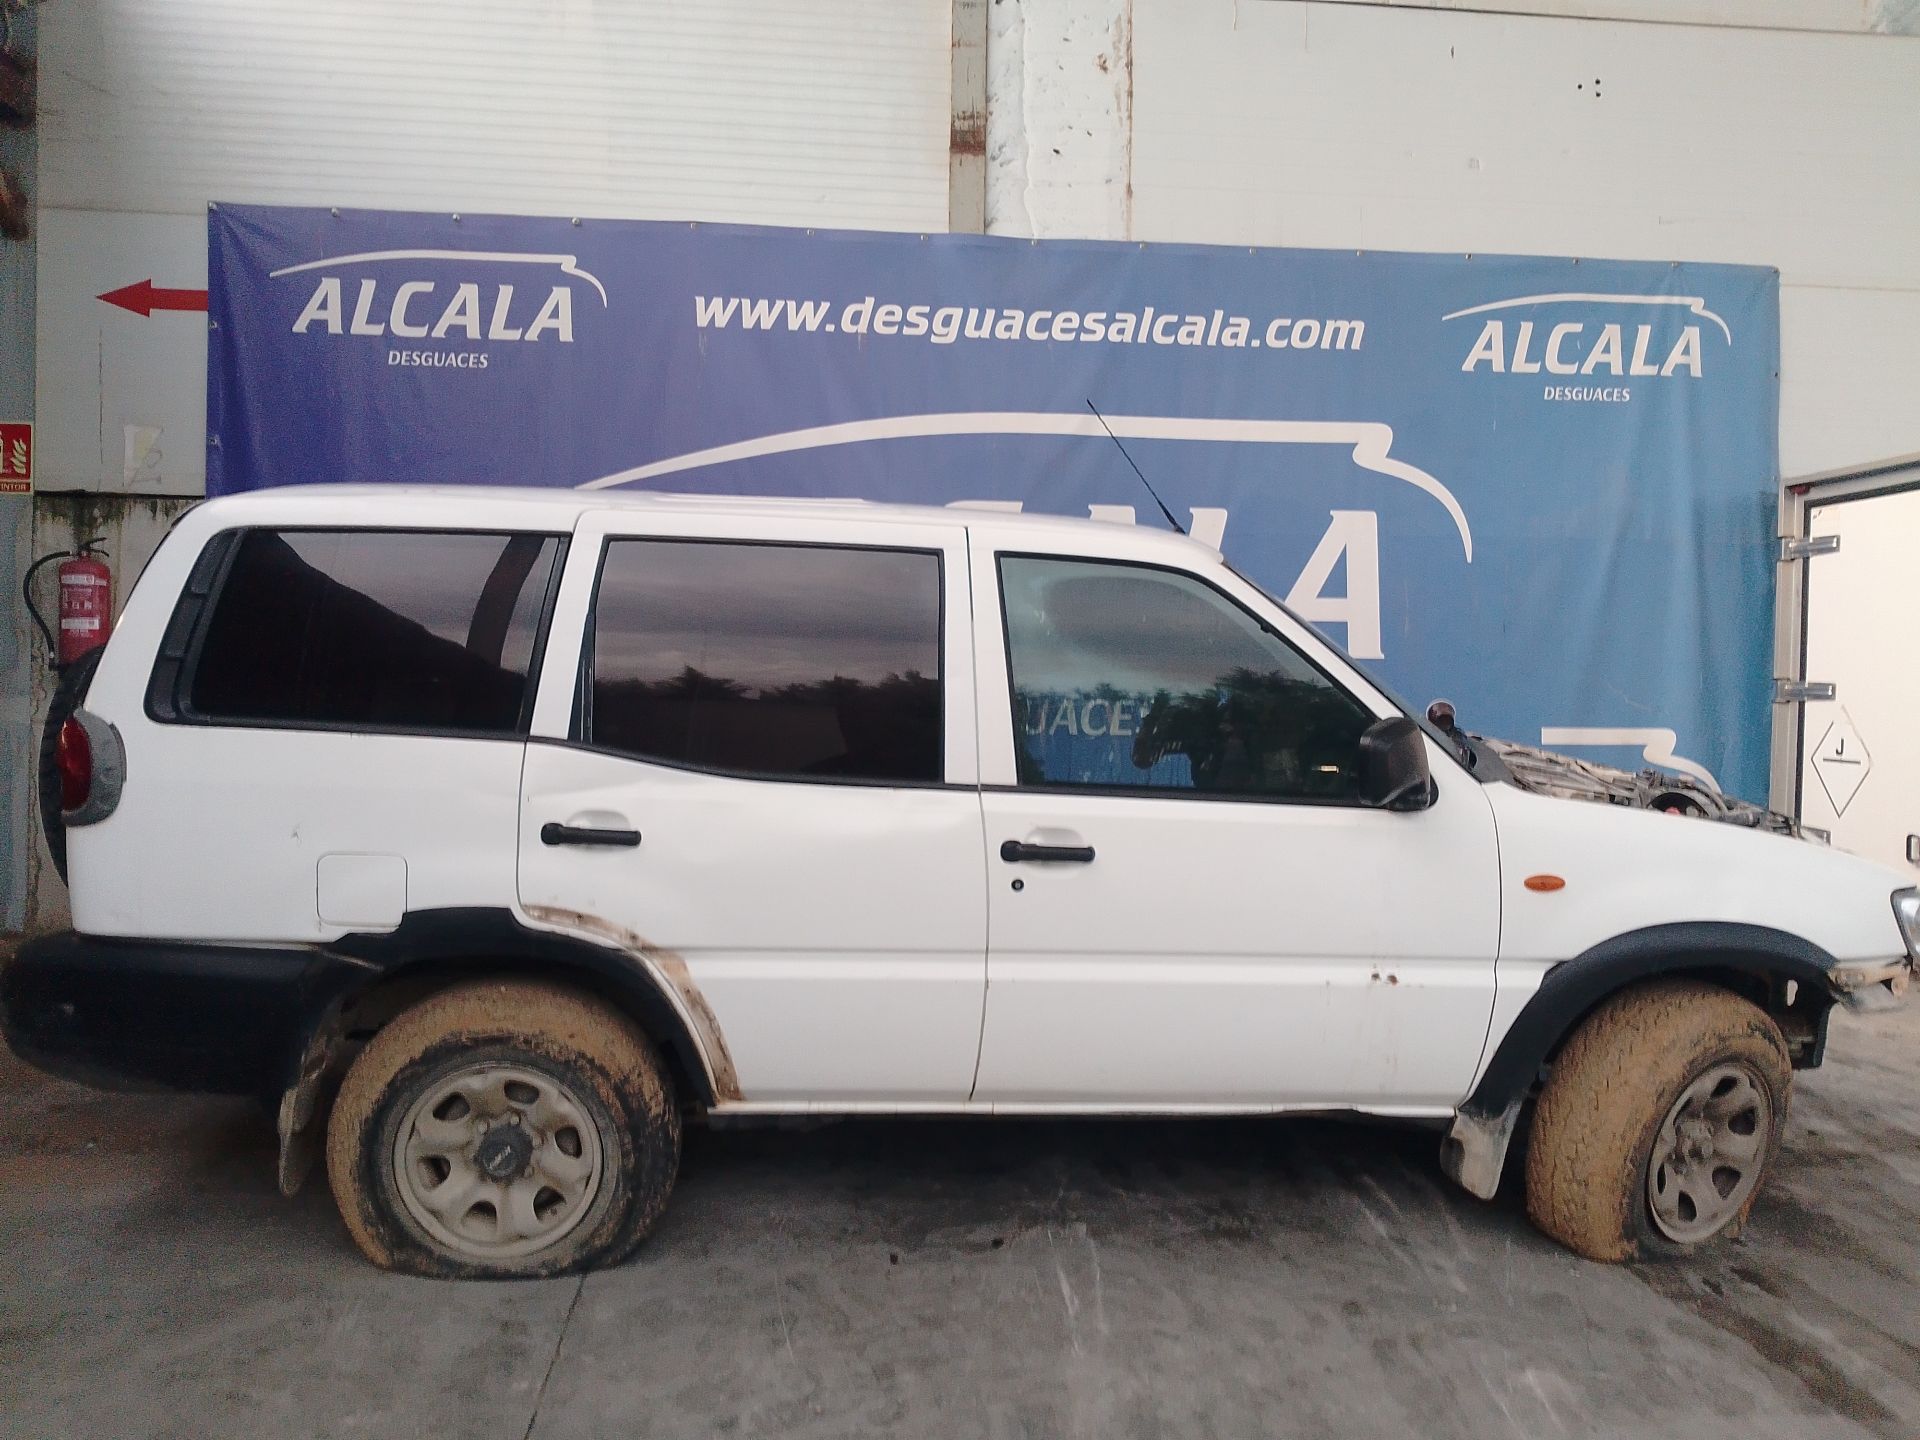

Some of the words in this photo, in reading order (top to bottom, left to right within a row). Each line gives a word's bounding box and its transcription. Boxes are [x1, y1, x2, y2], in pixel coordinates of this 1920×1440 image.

[291, 277, 574, 342] ALCALA
[695, 296, 1365, 350] www.desguacesalcala.com
[388, 350, 488, 368] DESGUACES
[1462, 320, 1703, 378] ALCALA
[1543, 386, 1630, 402] DESGUACES
